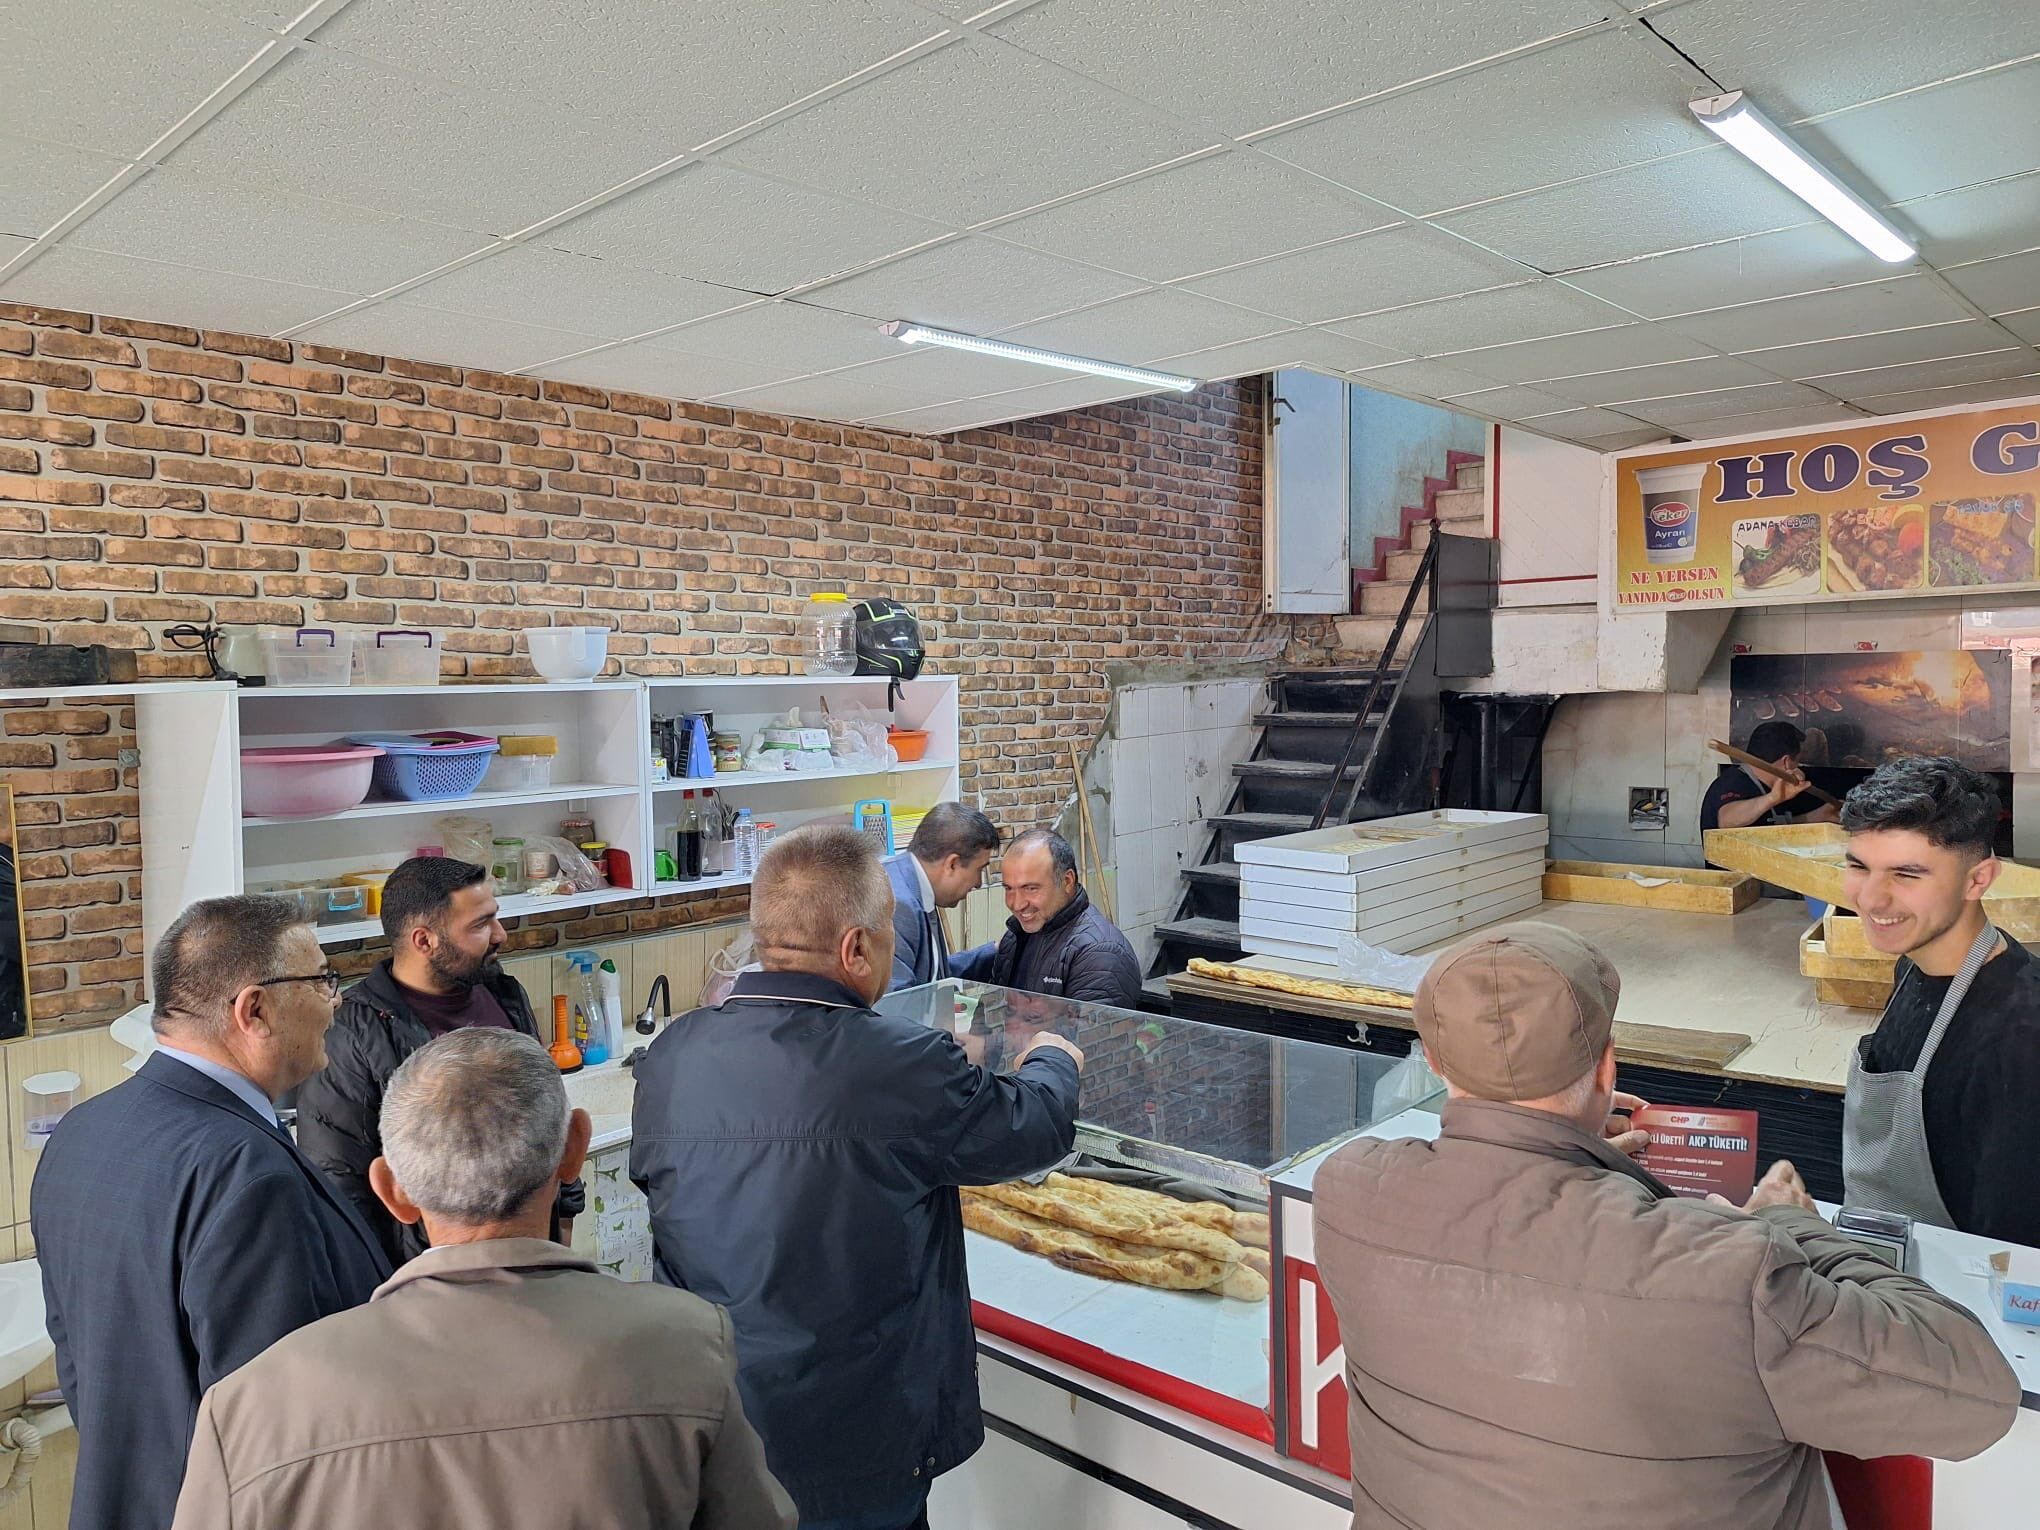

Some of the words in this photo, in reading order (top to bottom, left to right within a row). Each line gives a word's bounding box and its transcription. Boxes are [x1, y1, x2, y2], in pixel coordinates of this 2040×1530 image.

[1713, 434, 1931, 502] HOŞ
[1970, 421, 2040, 475] G
[1655, 530, 1686, 539] Ayran
[1738, 520, 1774, 532] ADANA
[1631, 571, 1650, 585] NE
[1656, 567, 1718, 583] YERSEN
[1619, 591, 1666, 604] YANINDA
[1688, 587, 1724, 601] OLSUN
[1670, 1115, 1690, 1124] CHP
[1660, 1133, 1685, 1146] ÜRETTİ
[1688, 1135, 1707, 1147] AKP
[1709, 1136, 1748, 1151] TÜKETTİ!
